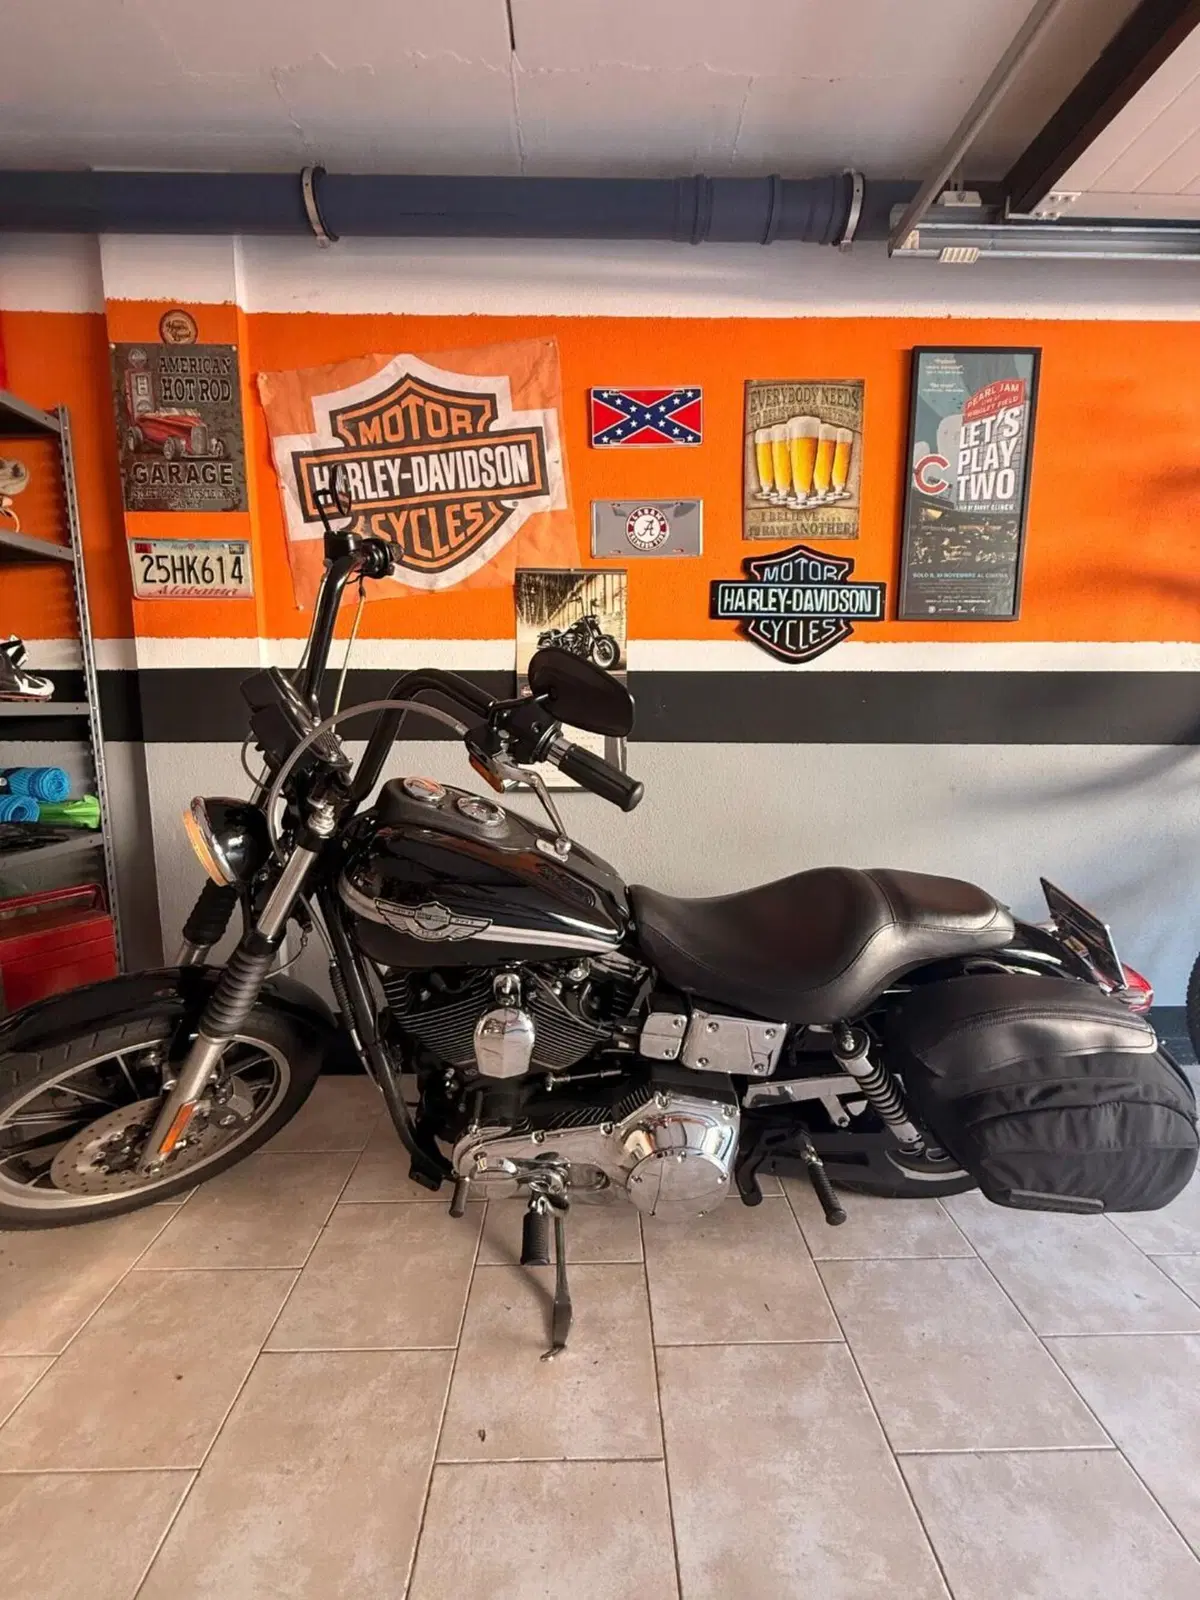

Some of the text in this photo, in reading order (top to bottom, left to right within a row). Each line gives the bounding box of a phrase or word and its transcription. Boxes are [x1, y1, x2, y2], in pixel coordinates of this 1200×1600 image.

[159, 356, 231, 374] AMERICAN
[161, 378, 231, 401] HOT ROD
[750, 387, 858, 412] EVERYBODY NEEDS
[967, 386, 996, 409] PEARL
[1000, 383, 1020, 392] JAM
[358, 395, 474, 446] MOTOR
[960, 407, 1021, 449] LET'S
[957, 437, 1018, 475] PLAY
[132, 461, 234, 487] GARAGE
[312, 443, 530, 506] HRLEY-DAVIDSON
[957, 468, 1015, 501] TWO
[629, 508, 665, 525] ALABAMA
[140, 554, 244, 585] 25HK614
[763, 557, 838, 582] MOTOR
[157, 585, 239, 597] Alabama
[723, 588, 872, 613] HARLEY-DAVIDSON
[759, 618, 836, 651] CYCLES
